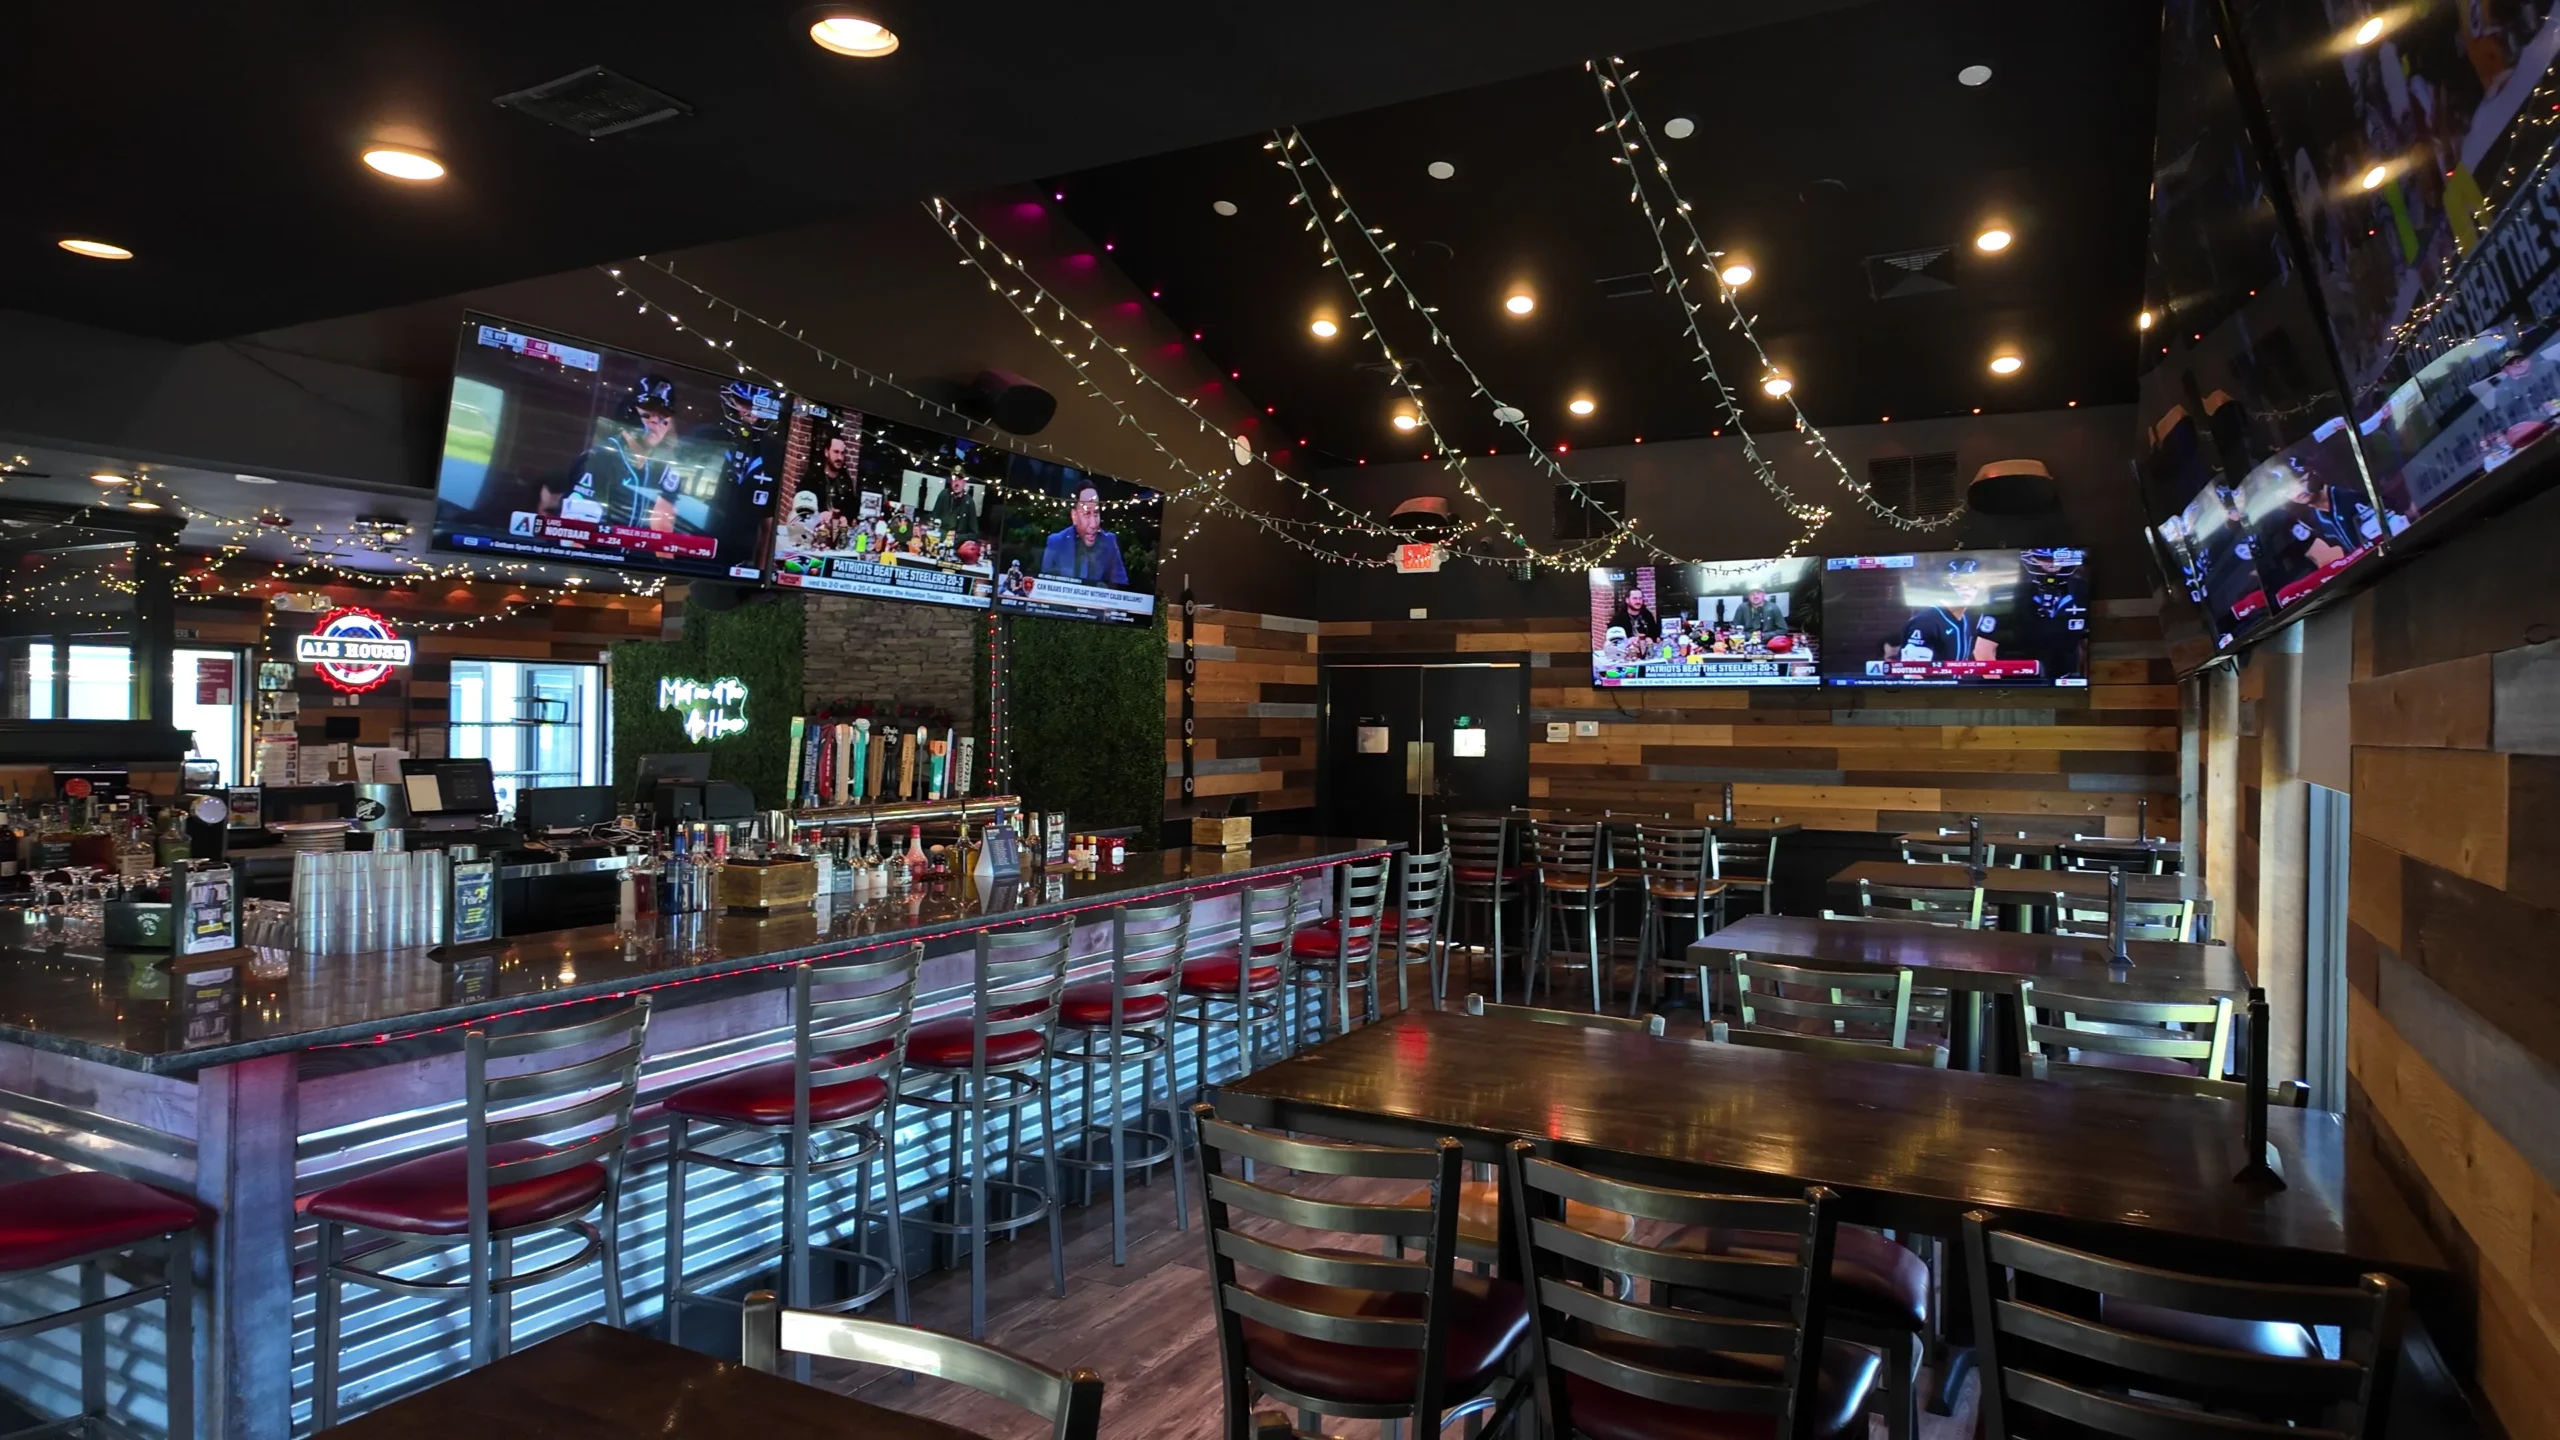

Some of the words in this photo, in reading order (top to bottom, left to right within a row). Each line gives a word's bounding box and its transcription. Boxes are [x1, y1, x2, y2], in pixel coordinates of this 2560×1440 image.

[545, 527, 590, 540] NOOTBAAR
[599, 525, 611, 534] 1-2
[833, 559, 873, 576] PATRIOTS
[873, 565, 894, 578] BEAT
[894, 568, 909, 580] THE
[910, 570, 946, 585] STEELERS
[947, 575, 964, 587] 20-3
[302, 641, 340, 658] ALE
[344, 643, 406, 660] HOUSE
[1645, 664, 1681, 673] PATRIOTS
[1682, 664, 1701, 673] BEAT
[1702, 664, 1718, 672] THE
[1720, 664, 1758, 672] STEELERS
[1759, 664, 1779, 672] 20-3
[964, 744, 974, 784] Coors
